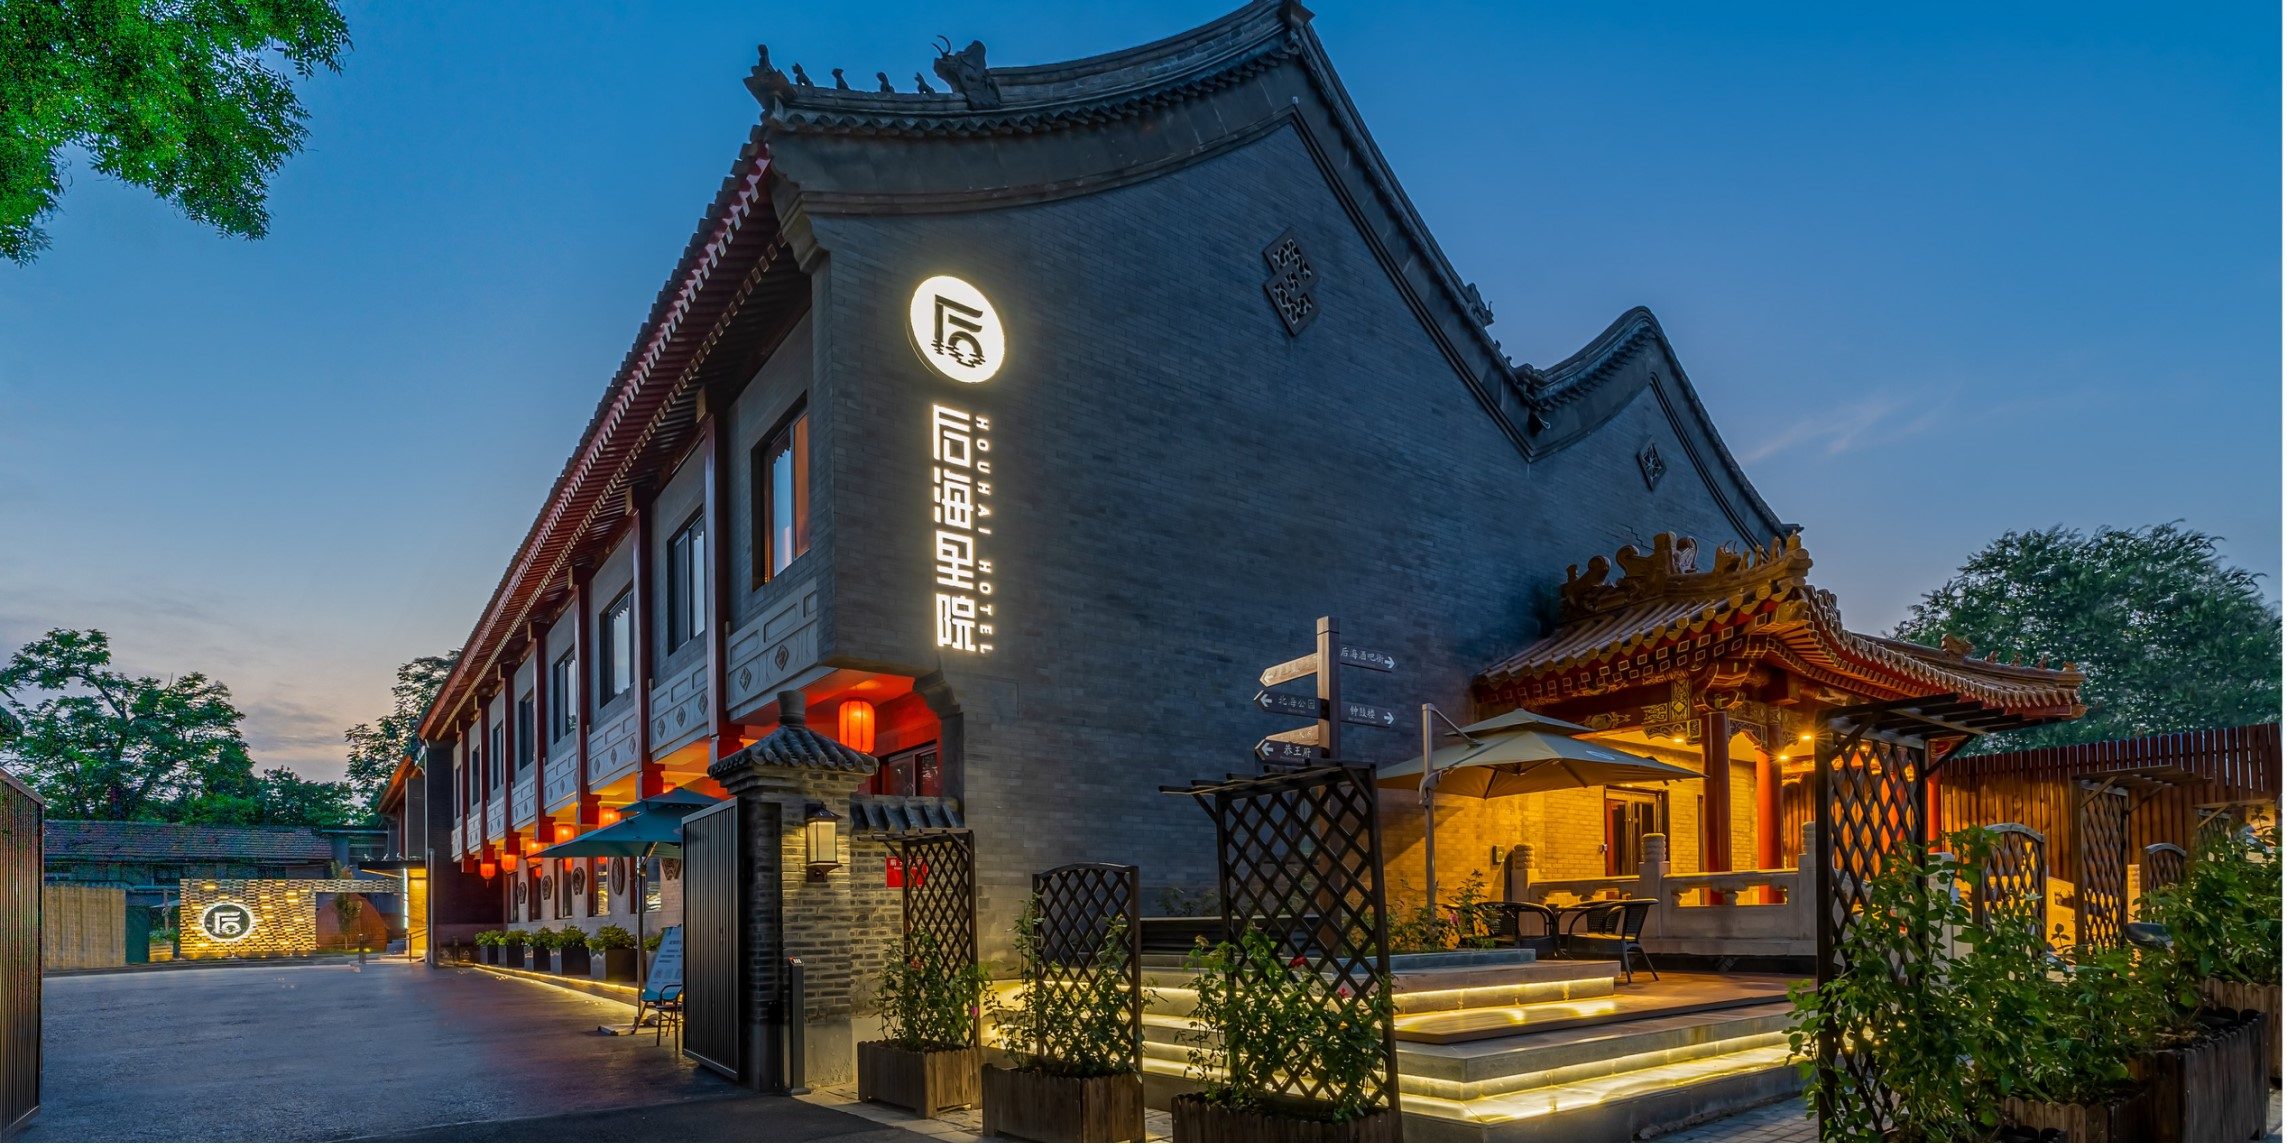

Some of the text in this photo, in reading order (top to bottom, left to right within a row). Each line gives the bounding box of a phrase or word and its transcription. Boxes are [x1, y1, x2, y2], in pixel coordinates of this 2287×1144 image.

[976, 415, 993, 654] HOUHAI HOTEL
[1341, 647, 1384, 664] 后海酒吧街
[1278, 695, 1316, 710] 北海公园
[1349, 705, 1376, 719] 钟鼓楼
[1283, 744, 1312, 758] 恭王府
